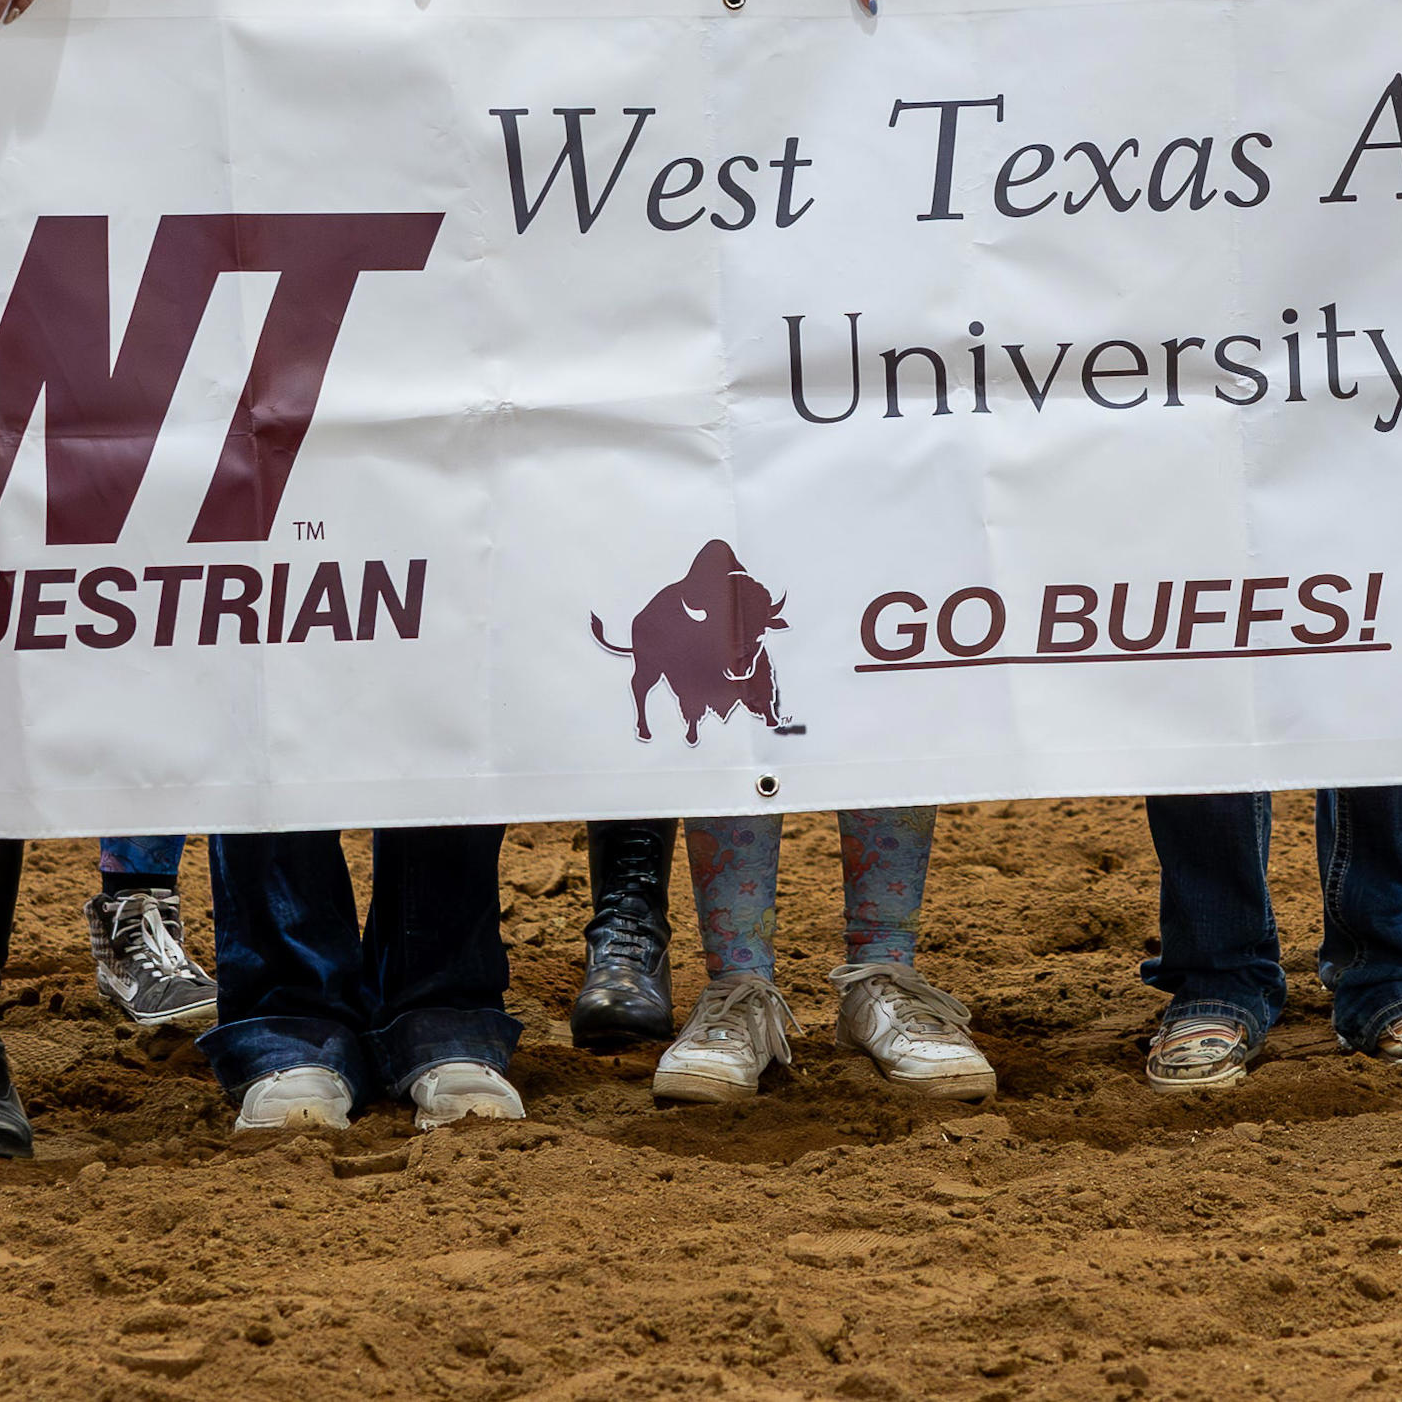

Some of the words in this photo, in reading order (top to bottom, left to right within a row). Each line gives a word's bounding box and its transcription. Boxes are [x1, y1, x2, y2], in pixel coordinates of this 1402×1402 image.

[489, 107, 814, 235] West
[888, 93, 1273, 222] Texas
[859, 585, 1007, 662] GO
[1036, 572, 1385, 654] BUFFS!
